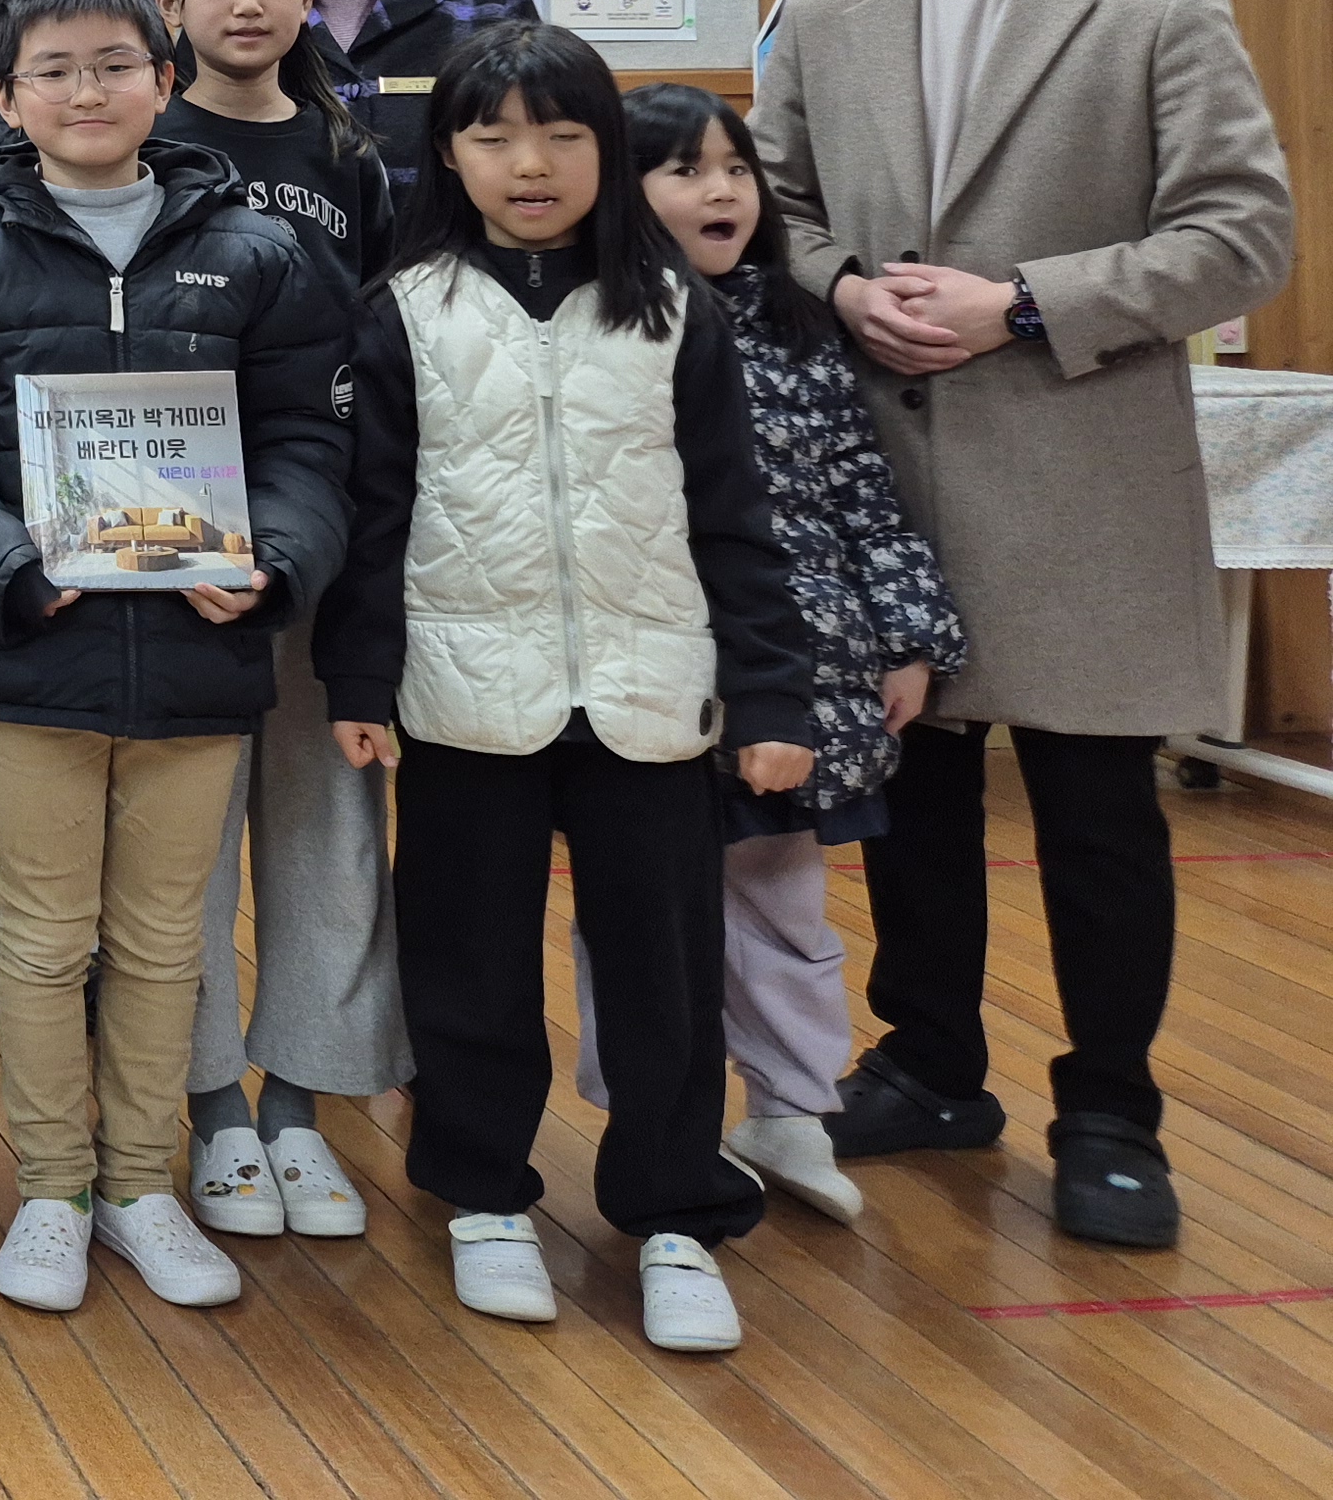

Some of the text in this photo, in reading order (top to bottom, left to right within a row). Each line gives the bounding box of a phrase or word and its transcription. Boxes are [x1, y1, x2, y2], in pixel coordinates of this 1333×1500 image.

[274, 182, 348, 239] CLUB
[34, 406, 226, 430] 파리지옥과 박거미의
[77, 438, 188, 461] 베란다 이웃
[158, 466, 196, 479] 지은이
